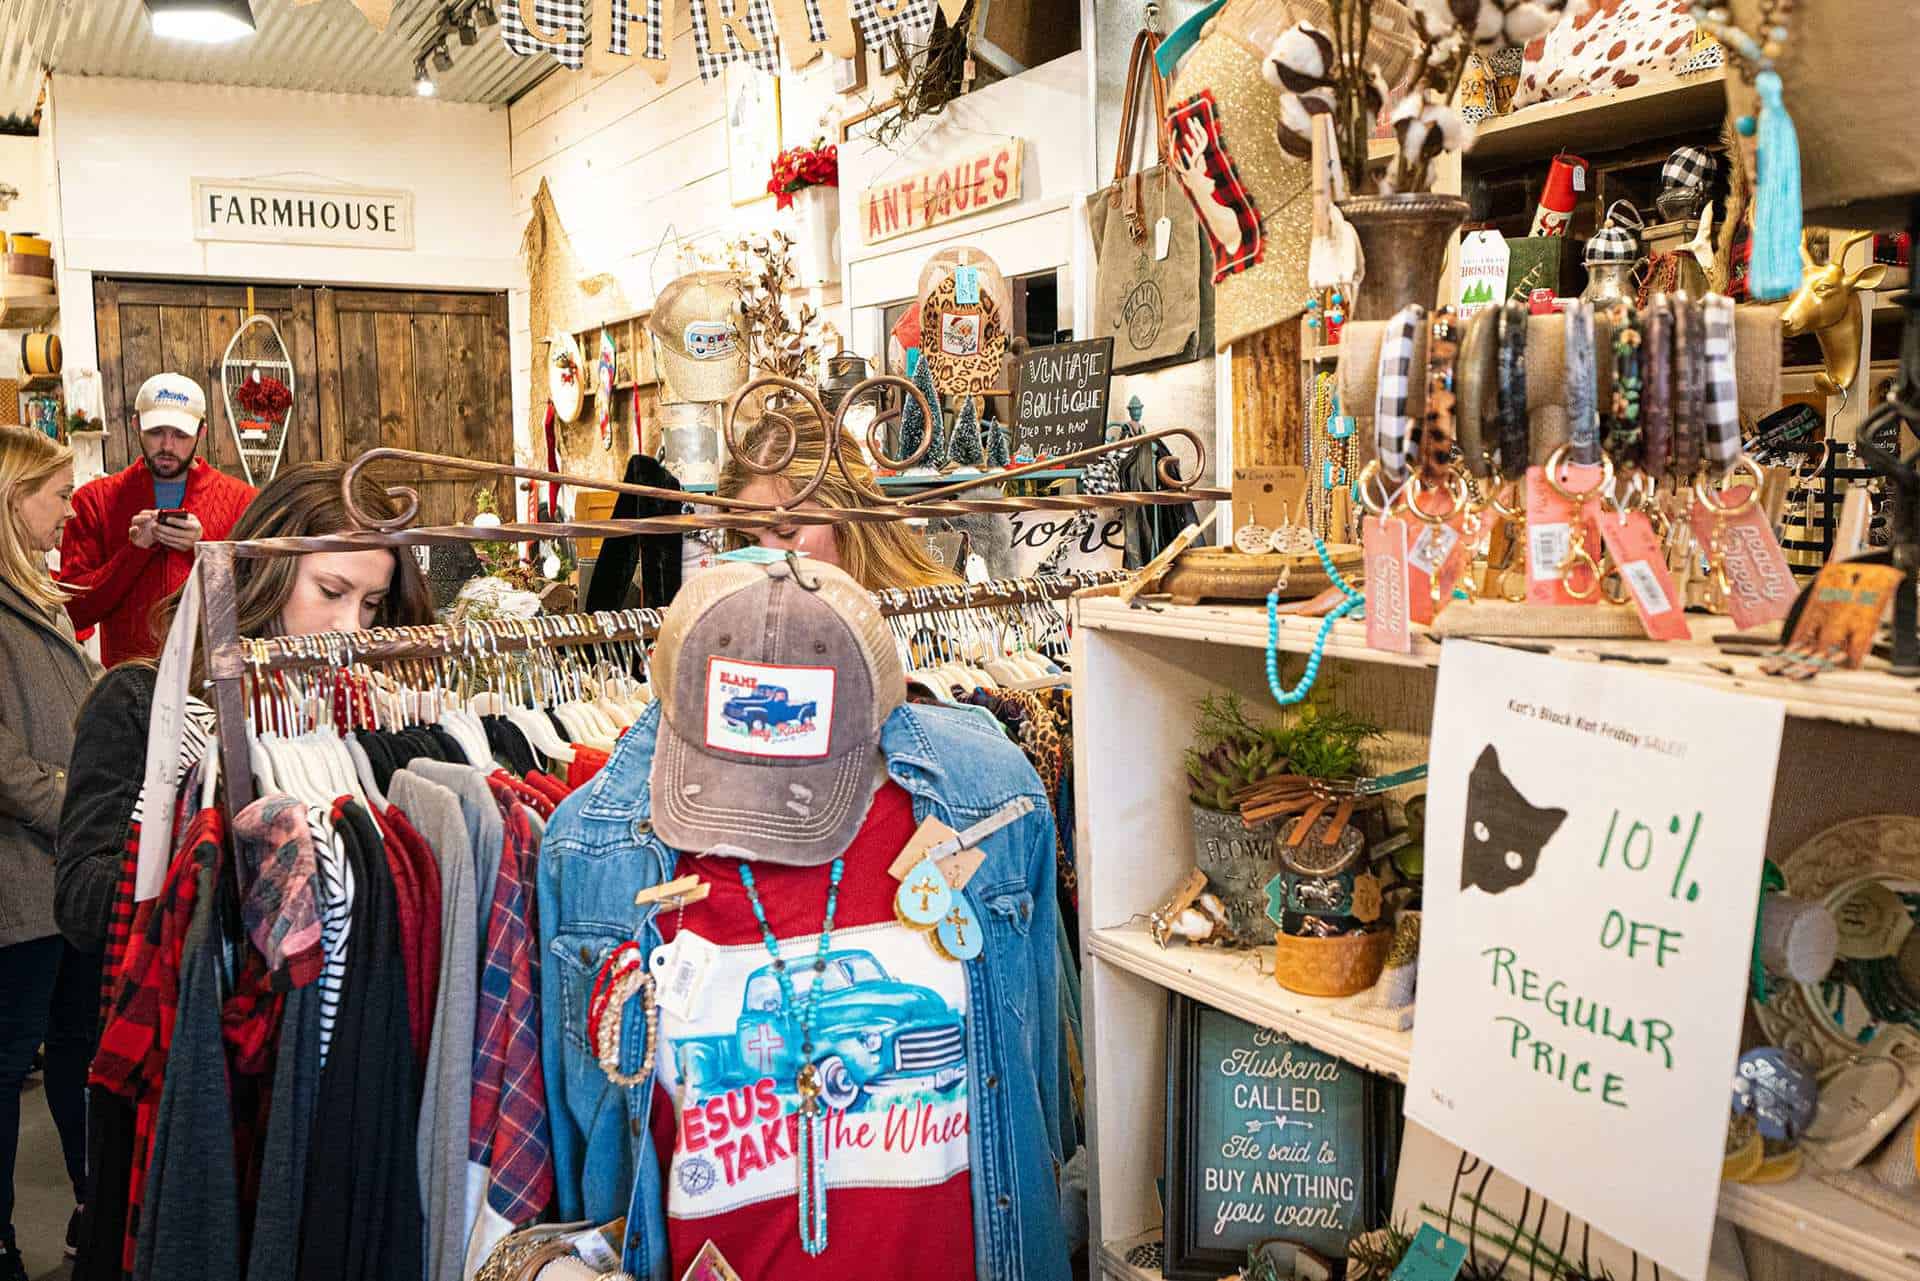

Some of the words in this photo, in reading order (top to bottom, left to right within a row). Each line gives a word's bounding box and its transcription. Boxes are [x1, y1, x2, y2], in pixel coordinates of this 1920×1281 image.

[868, 150, 1010, 238] ANTIQUES
[208, 194, 397, 232] FARMHOUSE
[1539, 706, 1571, 726] Black
[1207, 837, 1273, 862] FLOW
[1598, 808, 1702, 902] 10%
[1600, 908, 1683, 968] OFF
[1480, 946, 1674, 1069] REGULAR
[1221, 1048, 1340, 1081] Husband
[1495, 1016, 1628, 1108] PRICE
[1234, 1083, 1325, 1113] CALLED.
[822, 1105, 876, 1160] the
[1222, 1135, 1262, 1160] He
[1268, 1141, 1311, 1163] said
[1317, 1140, 1336, 1164] to
[1205, 1168, 1245, 1193] BUY
[1252, 1171, 1354, 1201] ANYTHING
[1214, 1199, 1265, 1235] you
[1274, 1202, 1343, 1230] want.
